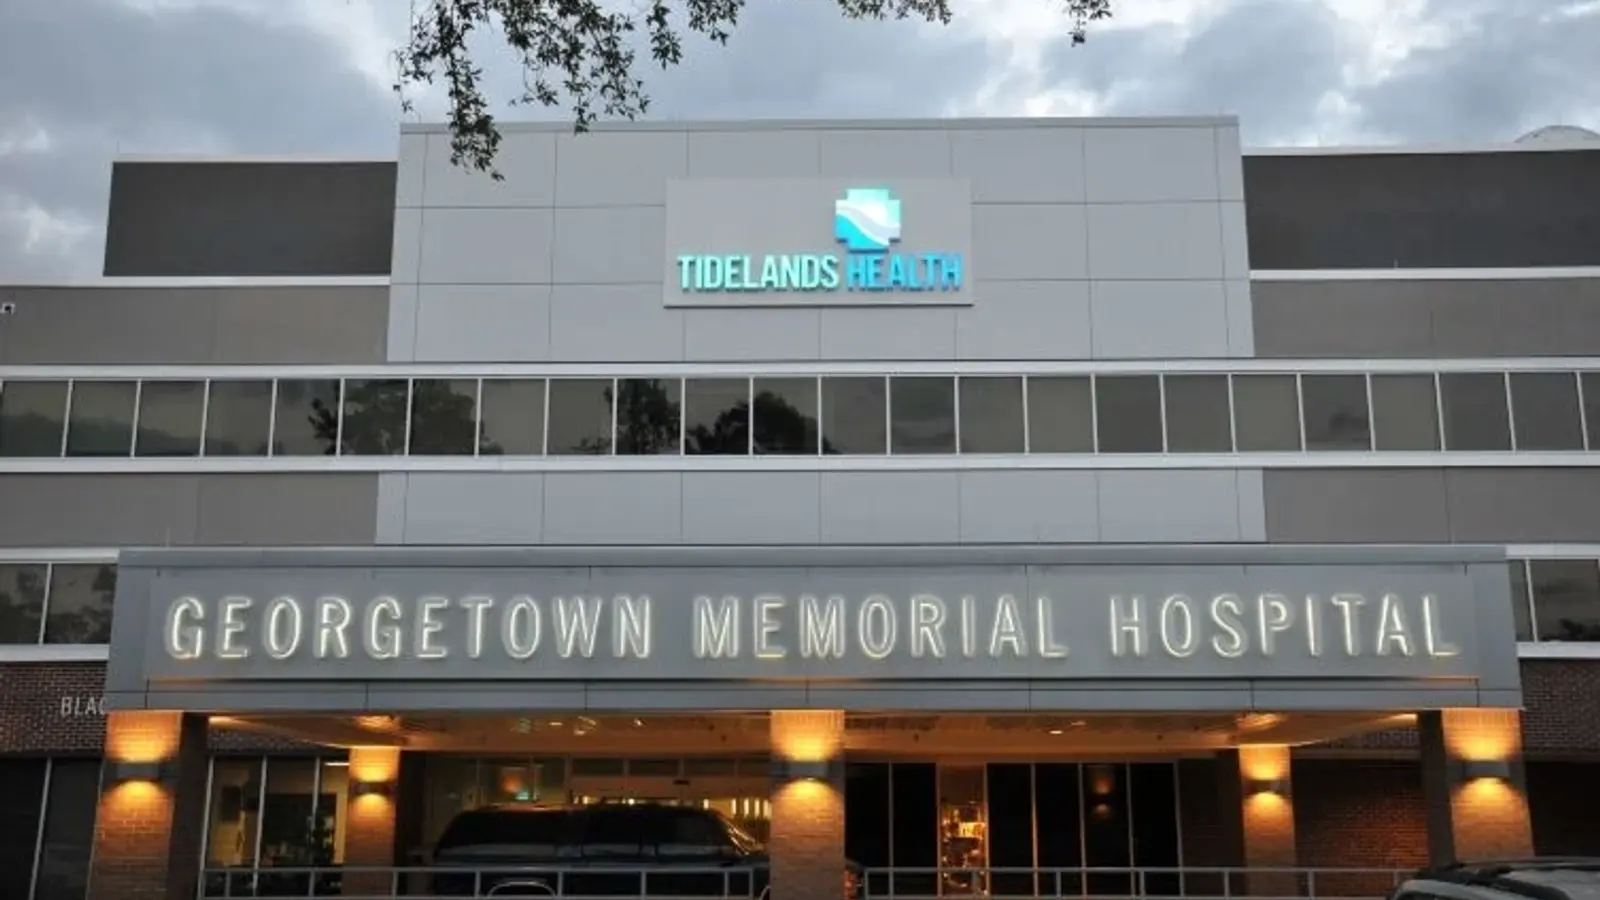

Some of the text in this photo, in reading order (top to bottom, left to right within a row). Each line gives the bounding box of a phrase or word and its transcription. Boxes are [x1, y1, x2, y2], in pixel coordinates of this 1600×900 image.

[677, 254, 964, 291] TIDELANDS HEALTH
[165, 592, 1462, 660] GEORGETOWN MEMORIAL HOSPITAL
